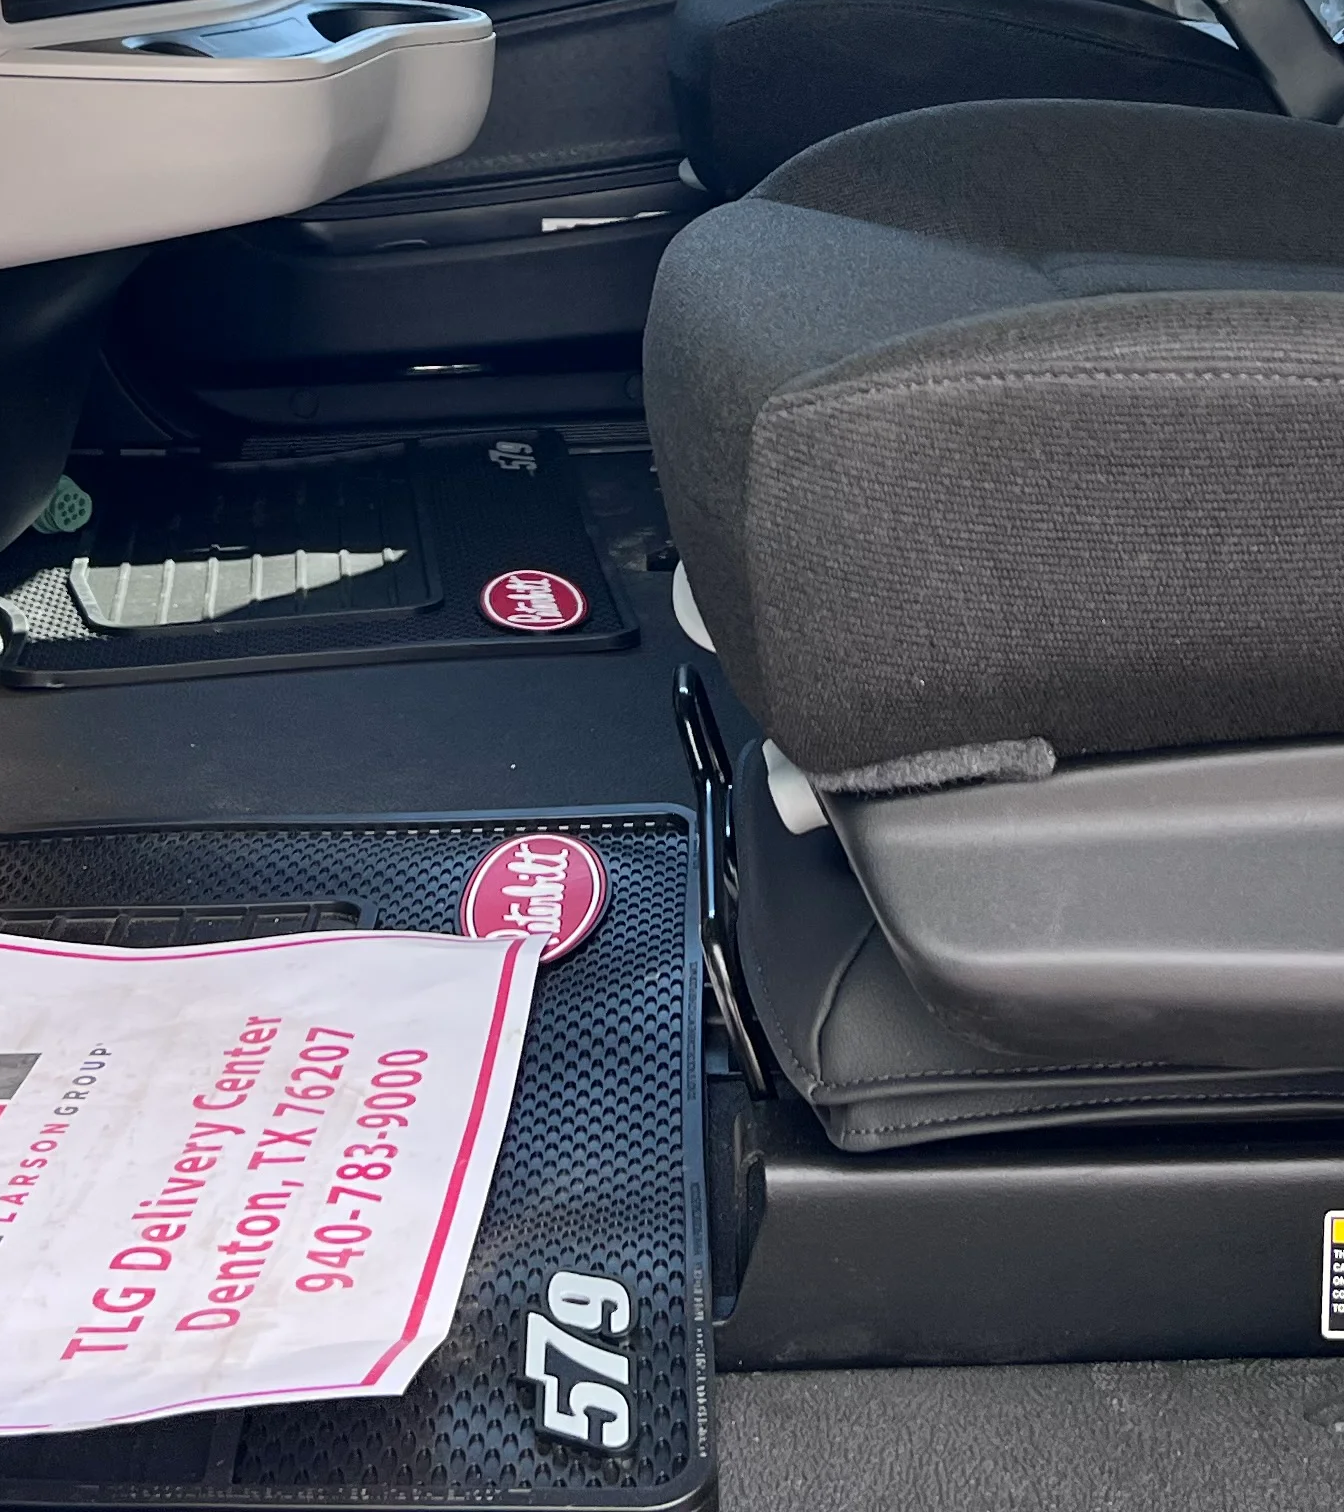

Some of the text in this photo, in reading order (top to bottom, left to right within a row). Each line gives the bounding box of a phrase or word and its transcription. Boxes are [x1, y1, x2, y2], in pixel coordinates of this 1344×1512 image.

[489, 442, 537, 472] 579
[54, 1048, 112, 1117] GROUP
[295, 1048, 428, 1293] 940-783-9000
[60, 1016, 283, 1360] TLG Delivery Center
[175, 1026, 355, 1331] Denton, TX 76207
[525, 1271, 631, 1448] 579
[1332, 1304, 1344, 1313] TO
